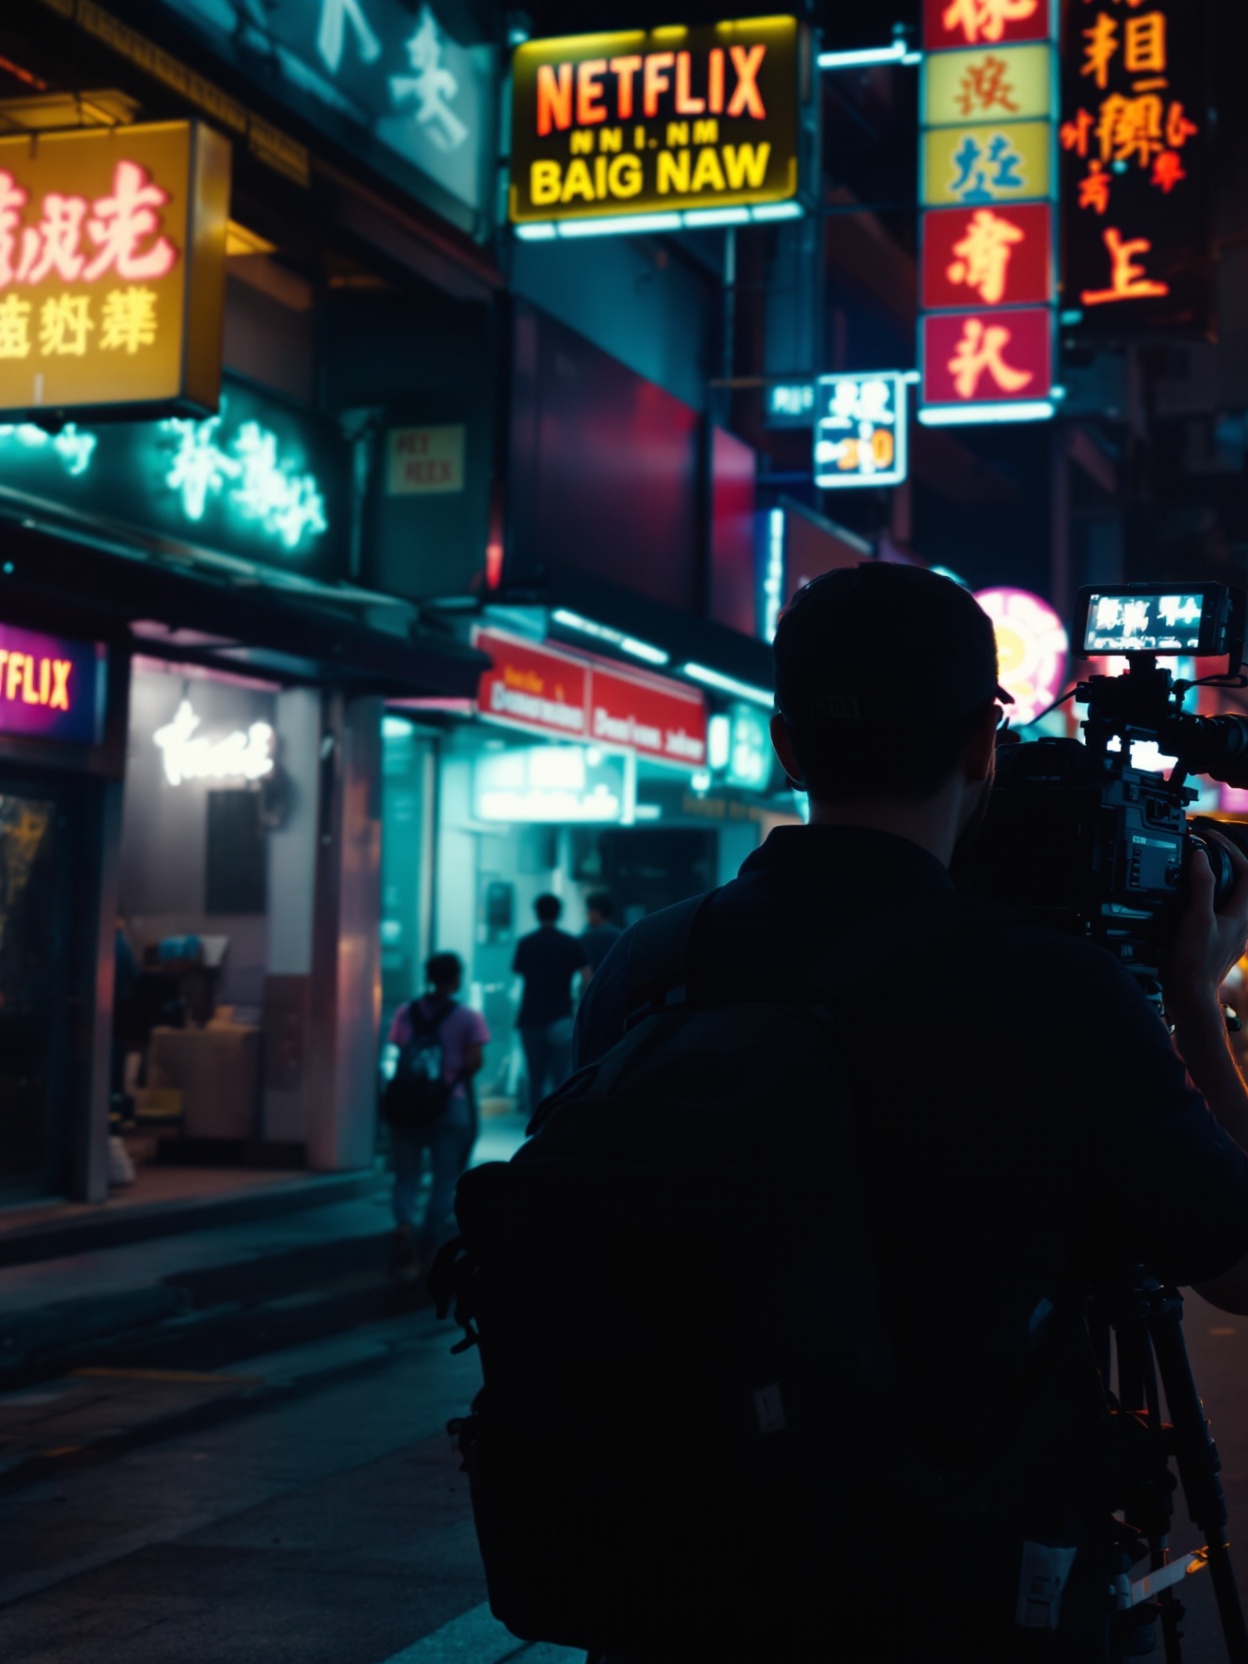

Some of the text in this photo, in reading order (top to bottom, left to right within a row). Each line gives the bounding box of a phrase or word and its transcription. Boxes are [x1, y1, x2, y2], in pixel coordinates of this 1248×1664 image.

[537, 44, 766, 137] NETFLIX
[530, 142, 771, 206] BAIG NAW
